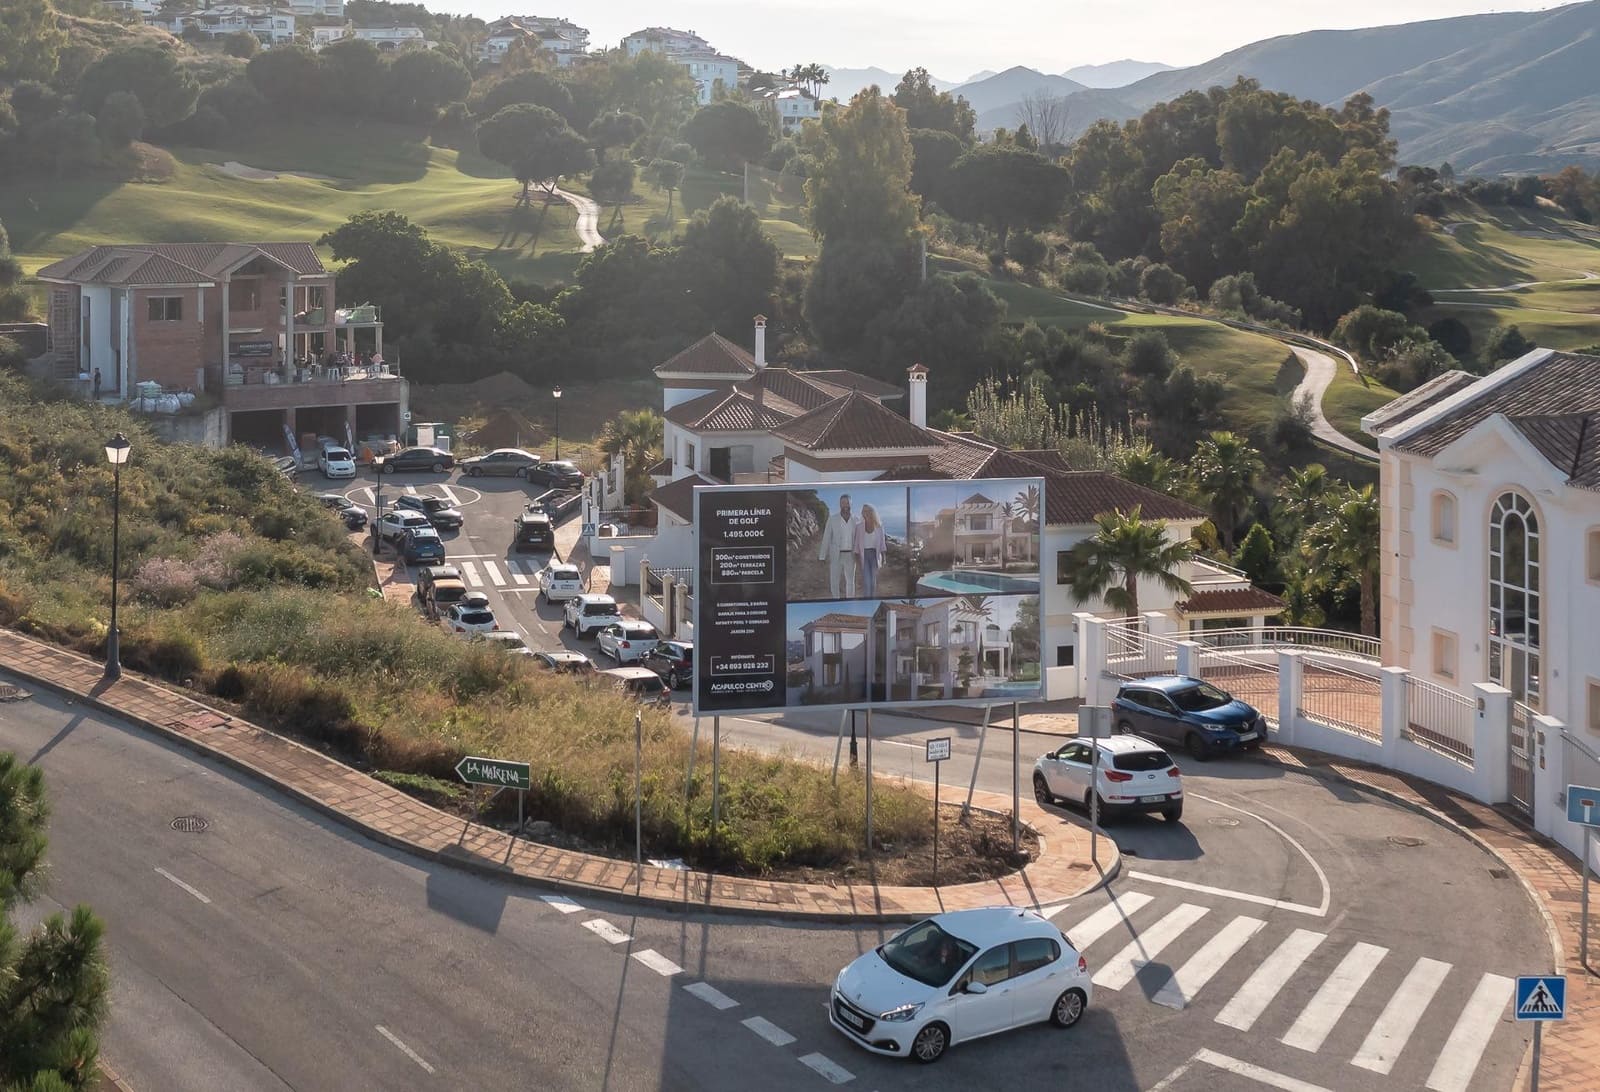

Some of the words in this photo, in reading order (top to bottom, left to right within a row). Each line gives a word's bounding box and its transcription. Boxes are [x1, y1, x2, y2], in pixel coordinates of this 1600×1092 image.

[716, 509, 749, 517] PRIMERA
[750, 507, 771, 516] LÍNEA
[740, 517, 759, 525] GOLF
[467, 762, 480, 775] LA
